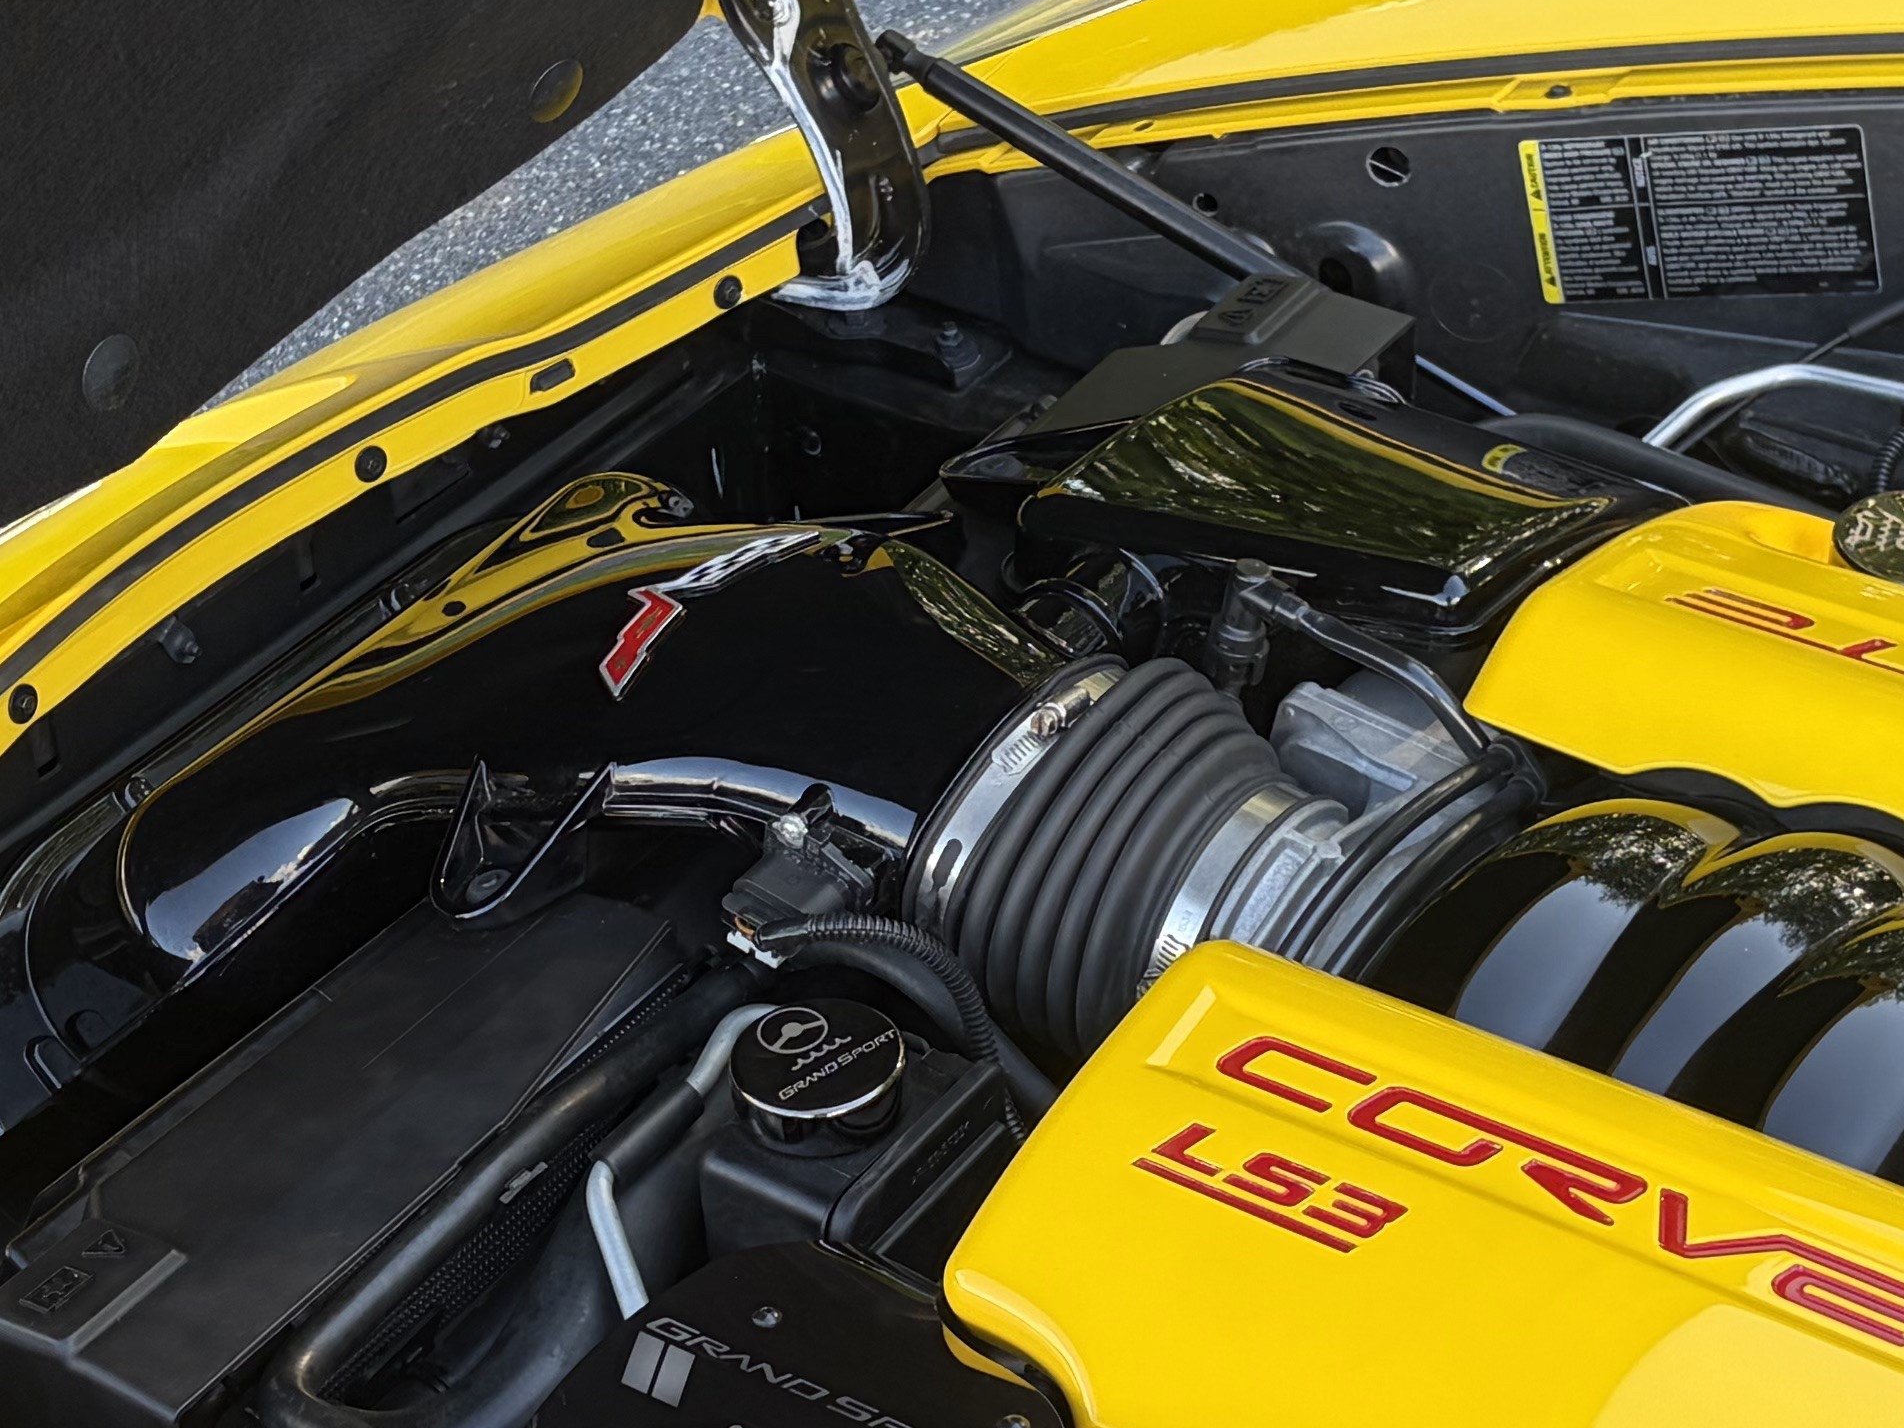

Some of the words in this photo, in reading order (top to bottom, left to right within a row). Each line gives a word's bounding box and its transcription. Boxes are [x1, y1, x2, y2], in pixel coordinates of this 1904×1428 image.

[778, 1061, 837, 1100] GRAND
[837, 1028, 898, 1067] SPORT
[1151, 1123, 1408, 1240] LS3
[646, 1316, 830, 1400] GRAND
